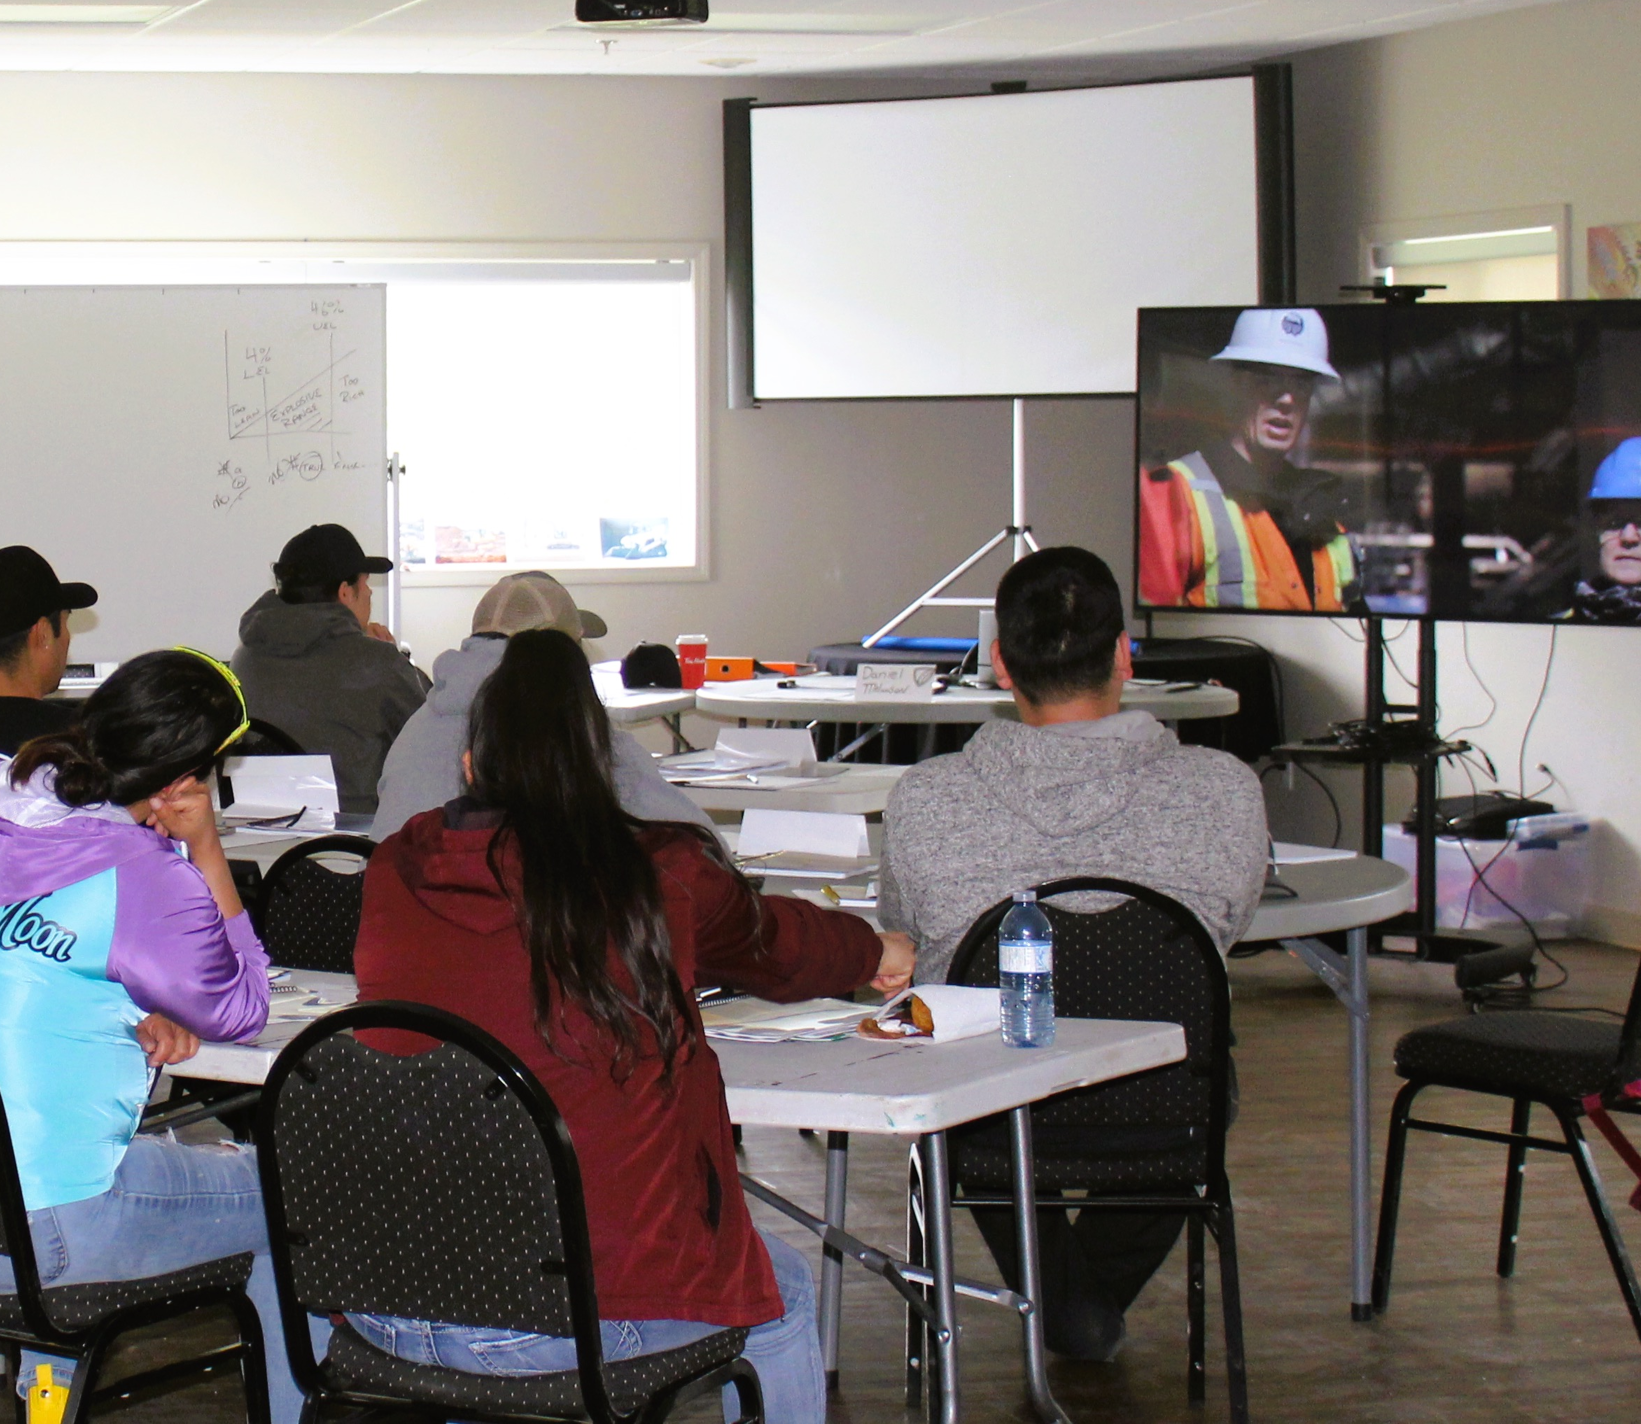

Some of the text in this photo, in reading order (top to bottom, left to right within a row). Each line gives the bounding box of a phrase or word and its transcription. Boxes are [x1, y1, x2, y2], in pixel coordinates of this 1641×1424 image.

[245, 346, 271, 364] 4%
[243, 365, 271, 380] LEL
[270, 388, 323, 422] EXPLOSIVE
[282, 405, 319, 429] RANGE
[862, 665, 904, 680] Daniel
